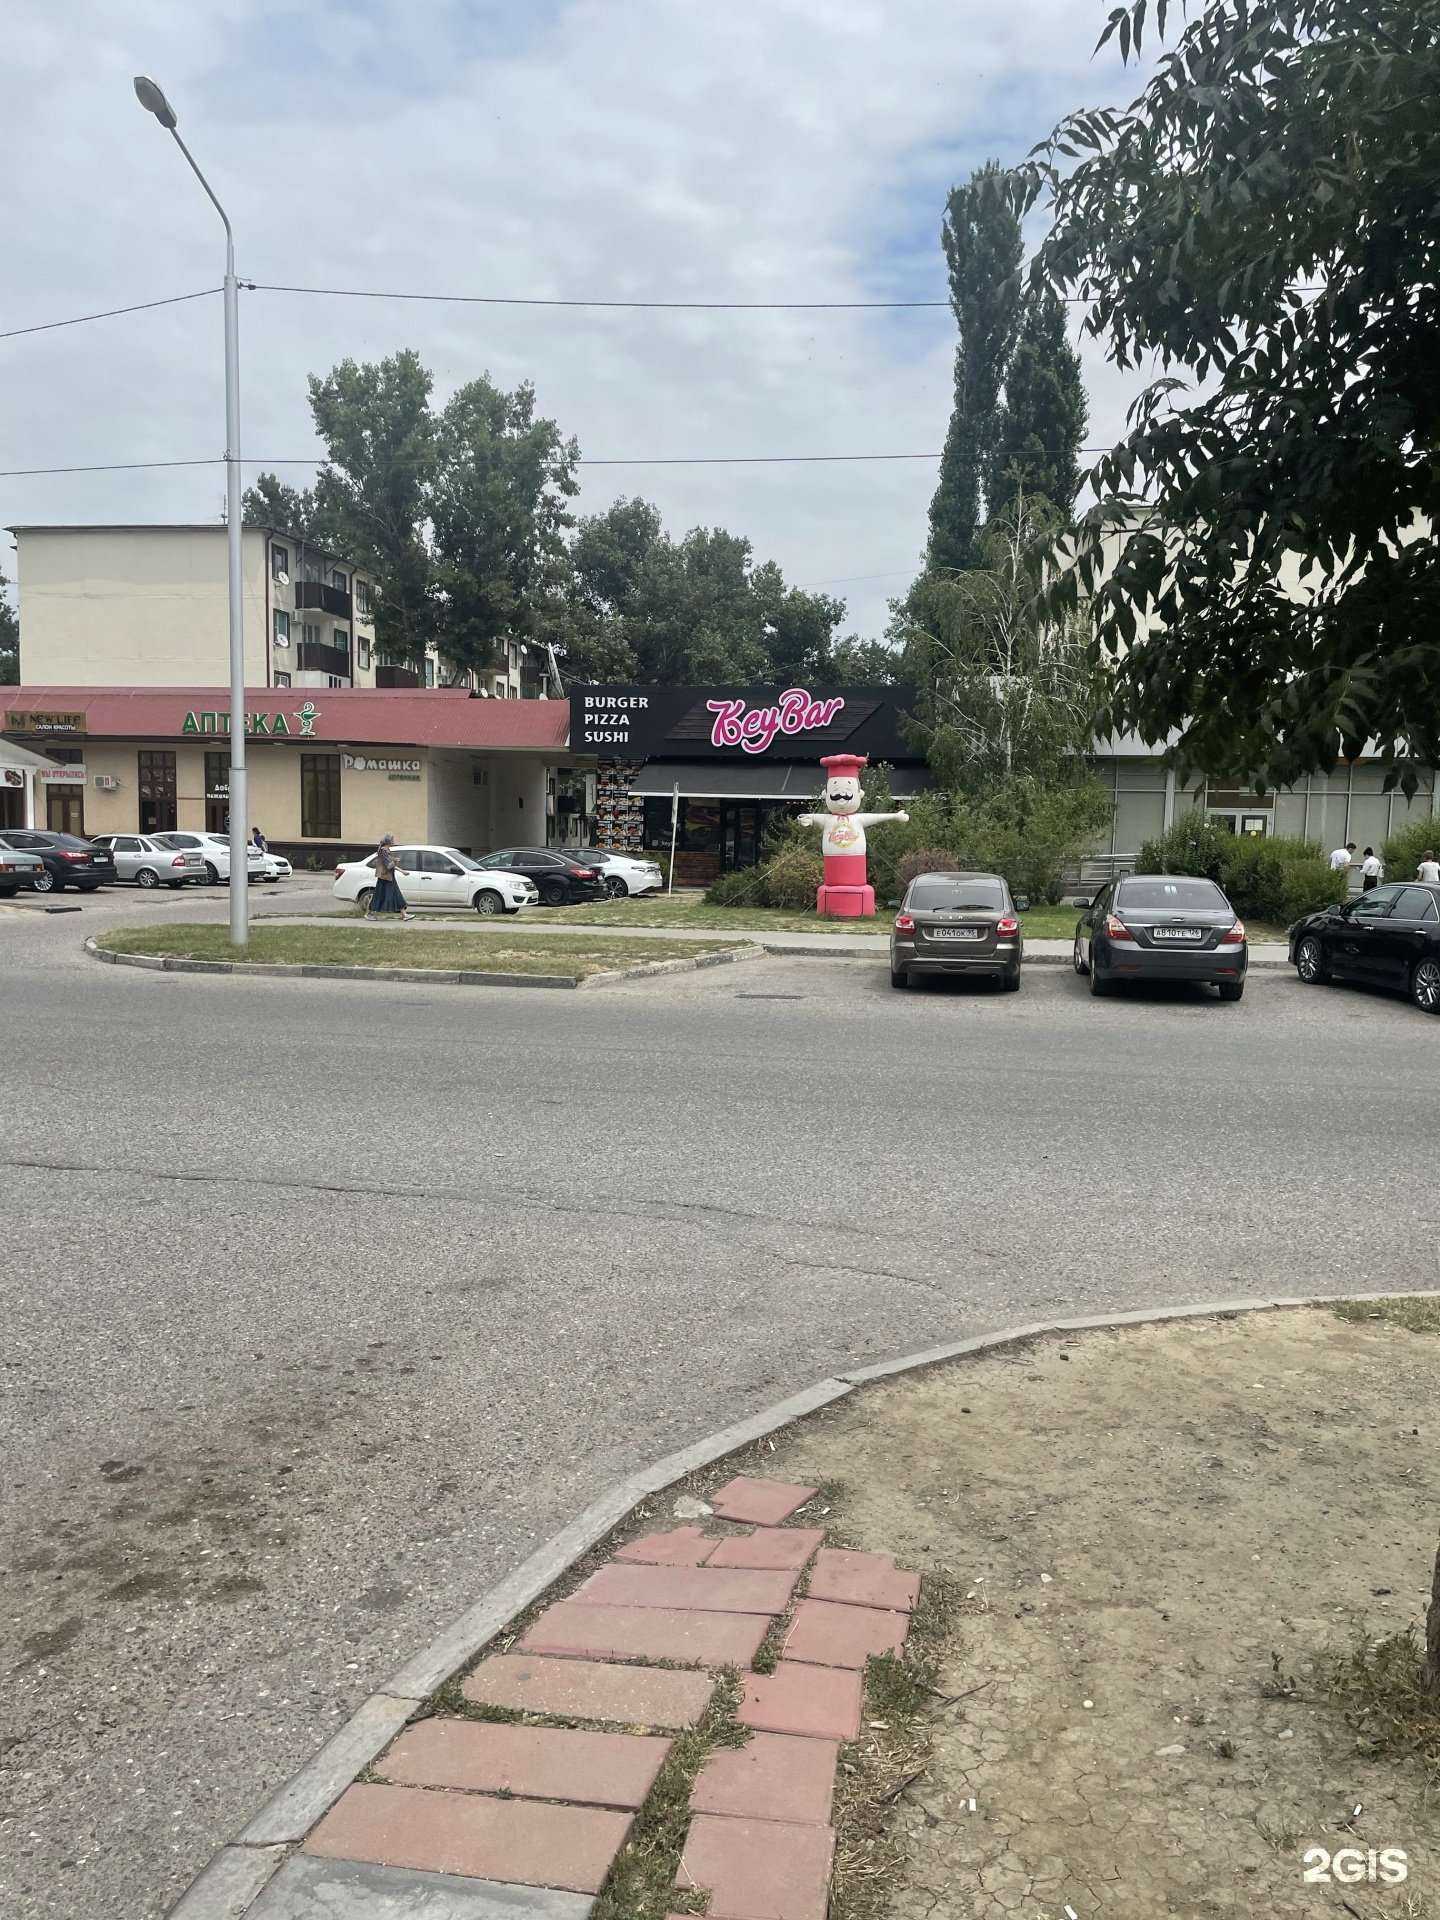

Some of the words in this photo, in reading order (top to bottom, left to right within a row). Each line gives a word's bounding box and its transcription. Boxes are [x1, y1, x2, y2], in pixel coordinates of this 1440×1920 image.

[584, 696, 649, 708] BURGER
[584, 713, 630, 725] PIZZA
[584, 731, 629, 743] SUSHI
